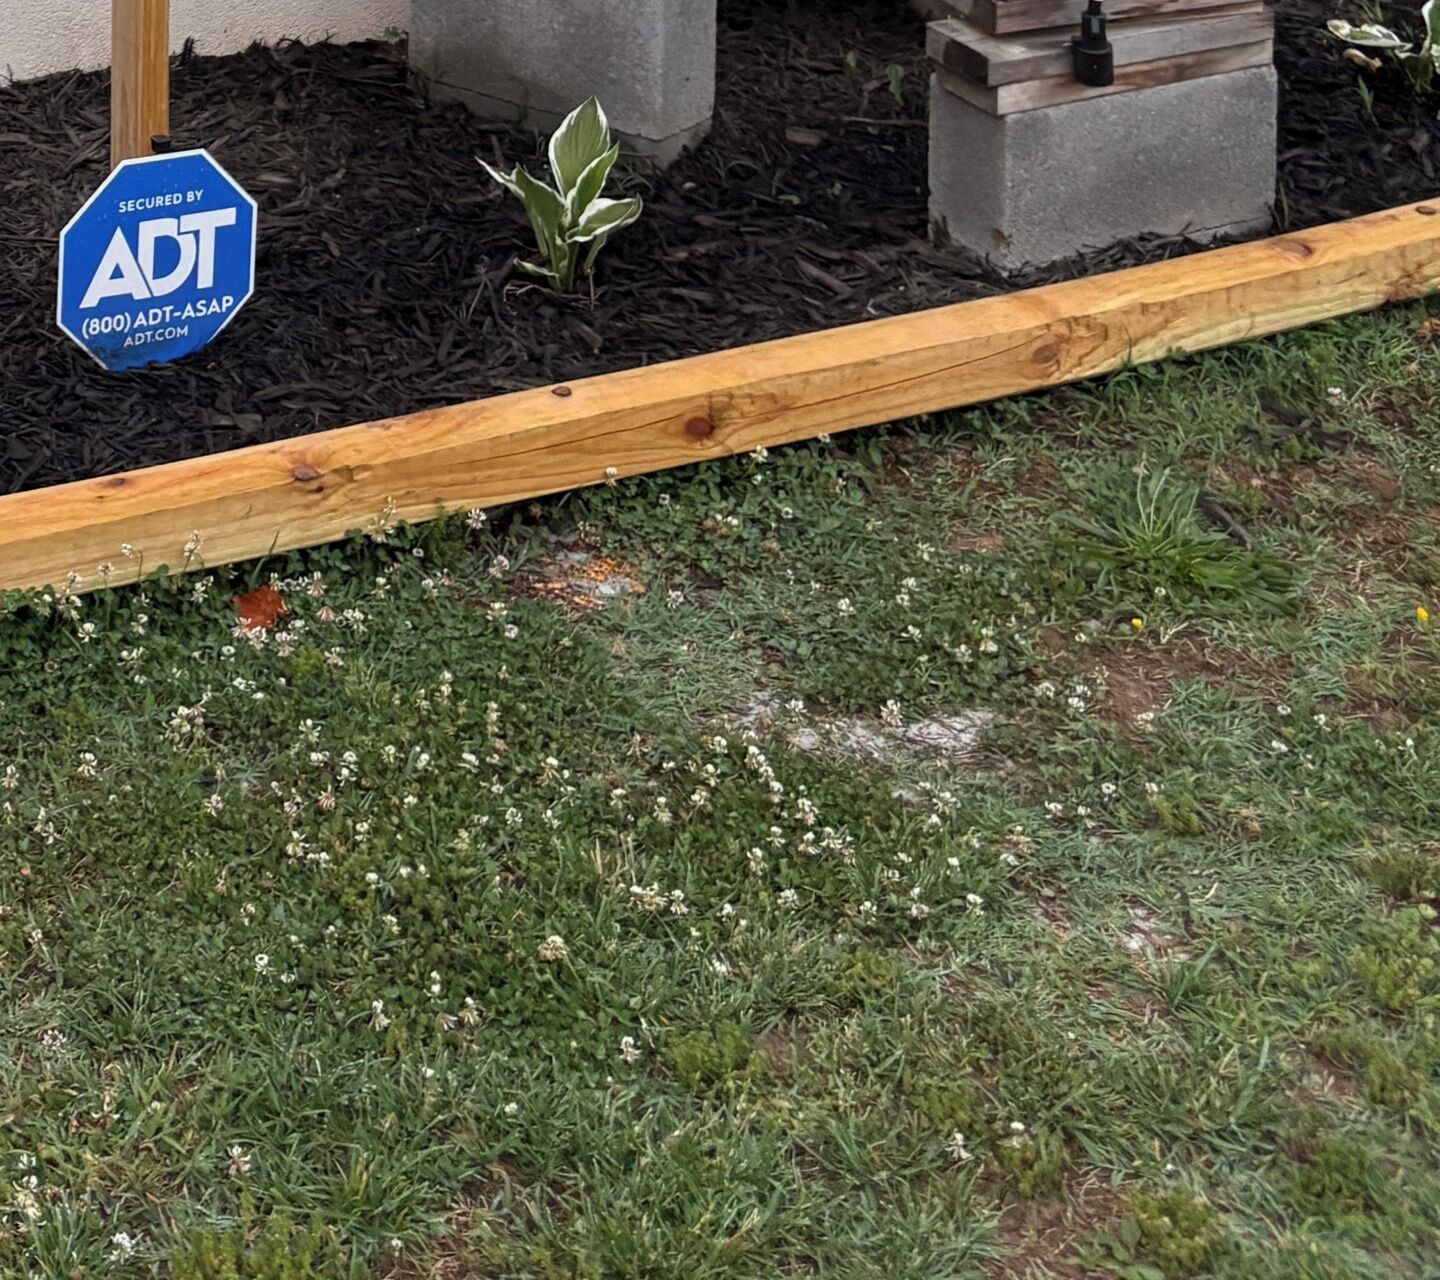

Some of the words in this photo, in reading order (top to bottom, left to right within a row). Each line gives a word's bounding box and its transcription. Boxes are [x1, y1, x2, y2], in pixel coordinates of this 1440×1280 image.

[118, 192, 183, 213] SECURED
[186, 188, 205, 203] BY
[78, 206, 237, 309] ADT
[81, 311, 132, 340] (800)
[133, 294, 234, 329] ADT-ASAP
[123, 324, 189, 348] ADT.COM
